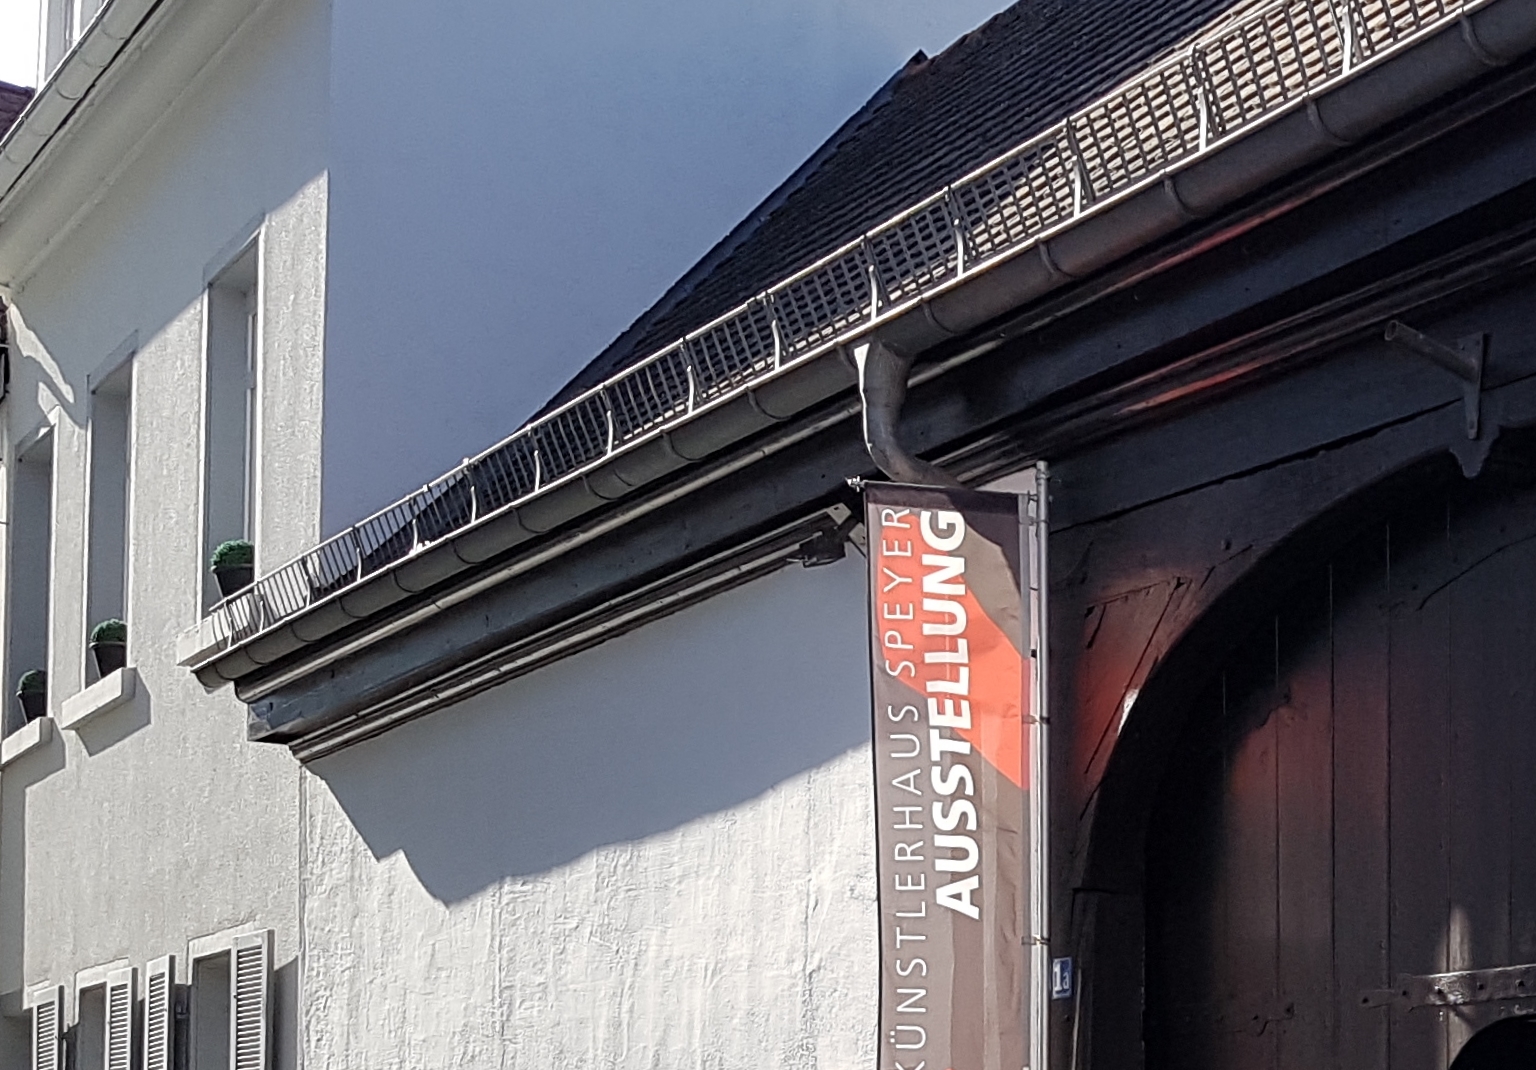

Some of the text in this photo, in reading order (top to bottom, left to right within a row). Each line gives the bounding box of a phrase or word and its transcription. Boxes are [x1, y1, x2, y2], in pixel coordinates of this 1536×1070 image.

[880, 507, 917, 678] SPEYER
[919, 509, 981, 921] AUSSTELLUNG
[1054, 962, 1070, 991] 1a
